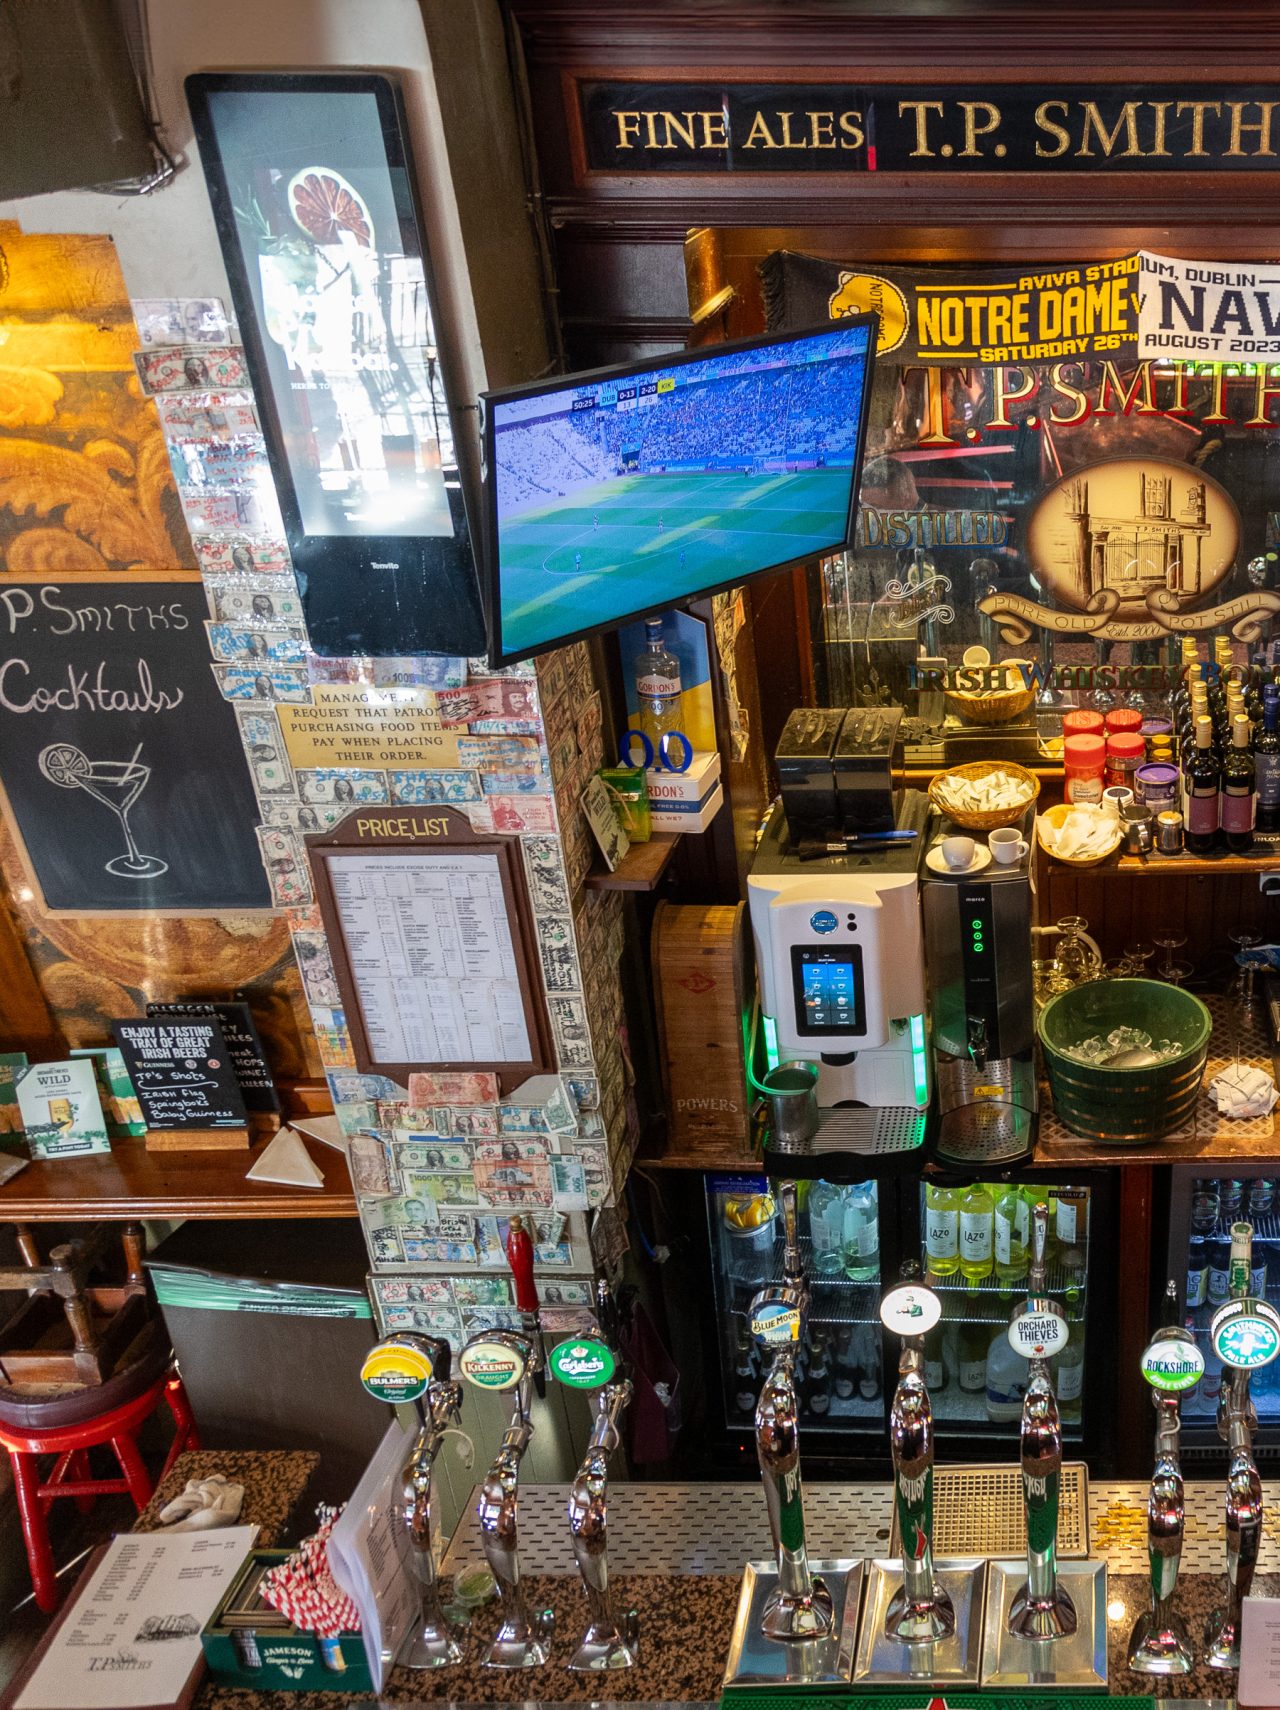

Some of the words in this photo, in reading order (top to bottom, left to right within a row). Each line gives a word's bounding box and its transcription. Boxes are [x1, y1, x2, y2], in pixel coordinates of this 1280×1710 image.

[612, 111, 729, 149] FINE
[742, 110, 865, 149] ALES
[898, 101, 1007, 158] T.P.
[1018, 270, 1080, 292] AVIVA
[1185, 268, 1256, 287] DUBLIN
[917, 293, 1032, 347] NOTRE
[1039, 278, 1129, 338] DAME
[980, 337, 1089, 363] SATURDAY
[1093, 332, 1139, 352] 26TH
[1144, 334, 1223, 351] AUGUST
[862, 507, 1009, 550] DISTILLED
[993, 596, 1048, 624] PURE
[1054, 616, 1097, 630] OLD
[1169, 615, 1208, 629] POT
[1214, 594, 1271, 623] STILL
[1131, 624, 1162, 638] 2000
[906, 663, 1011, 692] IRISH
[1, 658, 185, 714] Cocktails
[293, 707, 359, 719] REQUEST
[361, 706, 388, 718] THAT
[393, 706, 440, 718] PATRO
[290, 722, 374, 733] PURCHASING
[380, 721, 415, 732] FOOD
[312, 737, 335, 747] PAY
[341, 736, 380, 747] WHEN
[387, 736, 443, 746] PLACING
[335, 751, 375, 761] THEIR
[379, 751, 428, 761] ORDER.
[647, 785, 685, 799] RDON'S
[357, 818, 411, 837] PRICE
[413, 817, 449, 837] LIST
[120, 1026, 157, 1038] ENJOY
[159, 1026, 168, 1038] A
[167, 1026, 214, 1038] TASTING
[129, 1037, 160, 1049] TRAY
[161, 1037, 174, 1048] OF
[175, 1037, 210, 1048] GREAT
[141, 1048, 172, 1060] IRISH
[173, 1047, 208, 1059] BEERS
[36, 1074, 72, 1086] WILD
[676, 1098, 739, 1113] POWERS
[752, 1317, 777, 1333] BLUE
[776, 1311, 800, 1326] MOON
[1017, 1321, 1059, 1333] ORCHARD
[1018, 1329, 1060, 1342] THIEVES
[558, 1356, 605, 1374] Carlsberg
[1247, 1352, 1266, 1365] ALE
[466, 1362, 514, 1373] KILKENNY
[1146, 1359, 1199, 1374] ROCKSHORE
[368, 1377, 418, 1386] BULMERS
[263, 1646, 312, 1657] JAMESON
